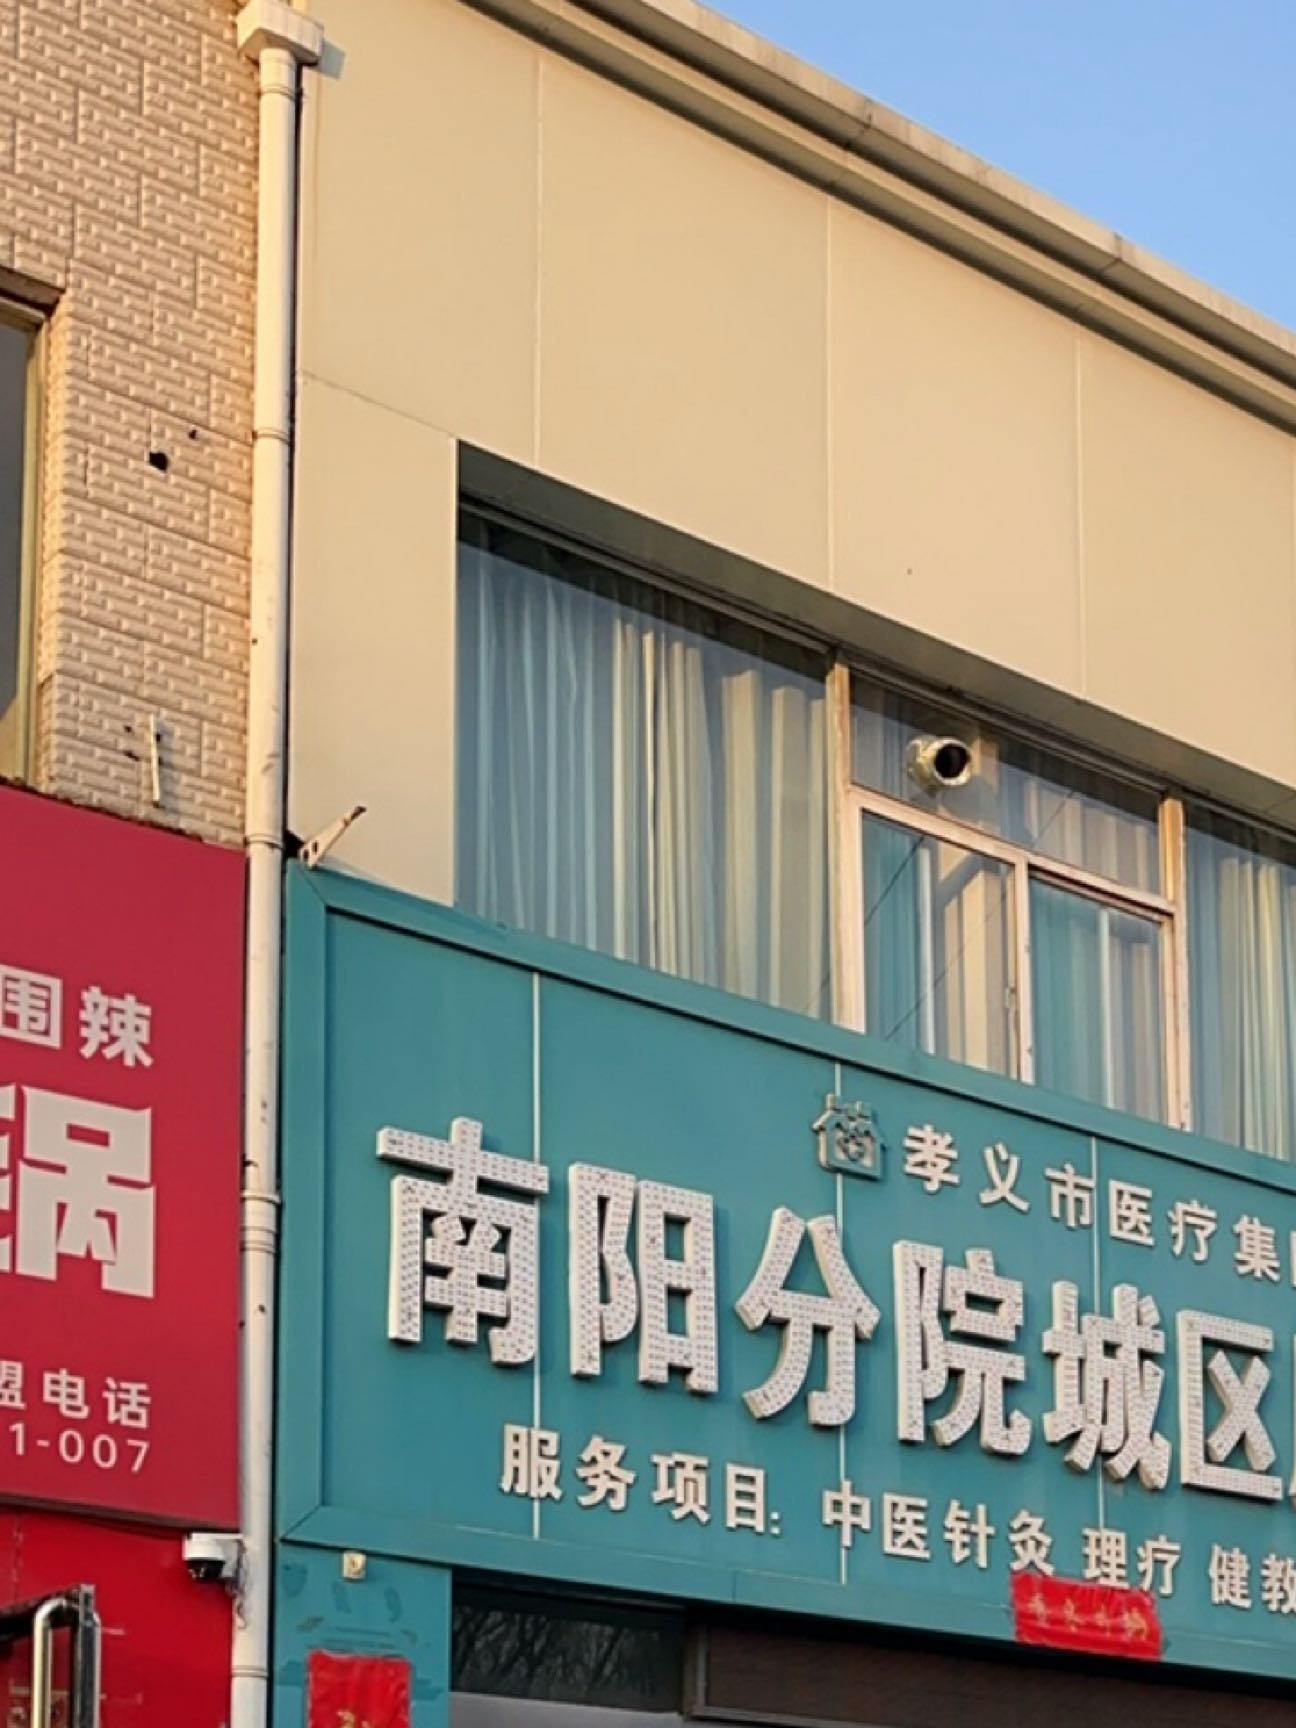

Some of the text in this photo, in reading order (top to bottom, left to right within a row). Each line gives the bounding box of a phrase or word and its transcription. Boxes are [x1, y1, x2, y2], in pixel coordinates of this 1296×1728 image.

[0, 964, 153, 1067] 围辣
[9, 1421, 150, 1473] 1-007
[821, 1480, 1053, 1574] 中医针灸
[1083, 1527, 1180, 1599] 理疗
